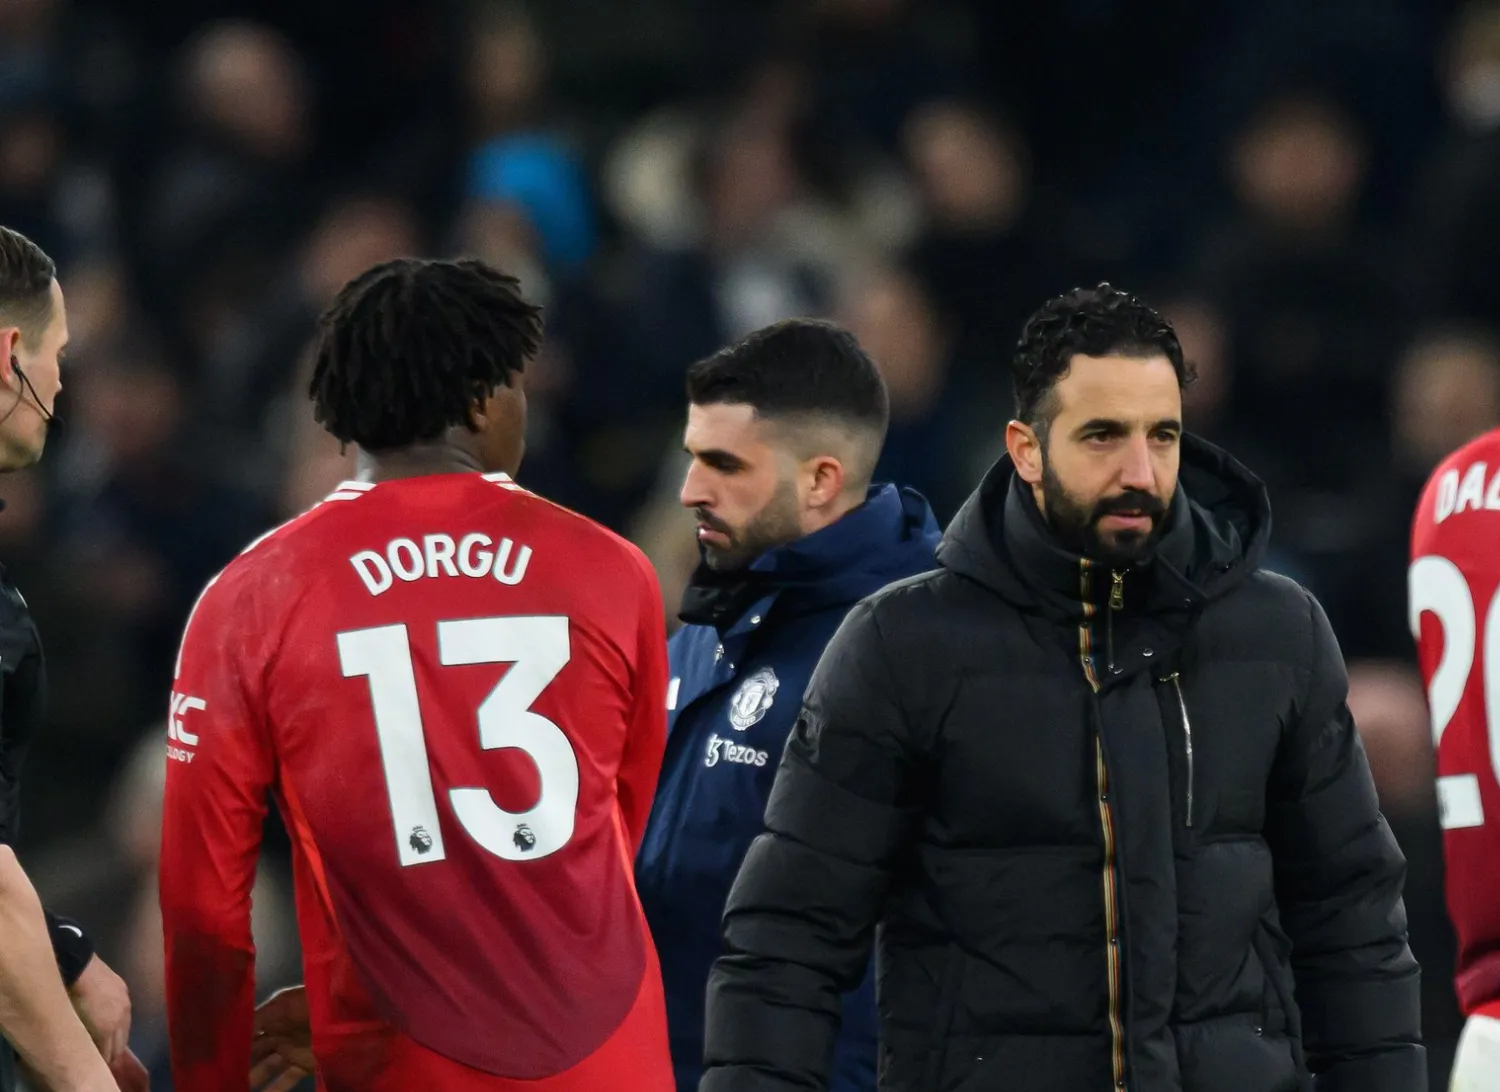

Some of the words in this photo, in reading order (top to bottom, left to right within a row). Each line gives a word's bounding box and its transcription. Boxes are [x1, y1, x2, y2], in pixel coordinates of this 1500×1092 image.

[350, 533, 533, 596] DORGU
[337, 615, 579, 867] 13
[723, 738, 769, 767] Tezos
